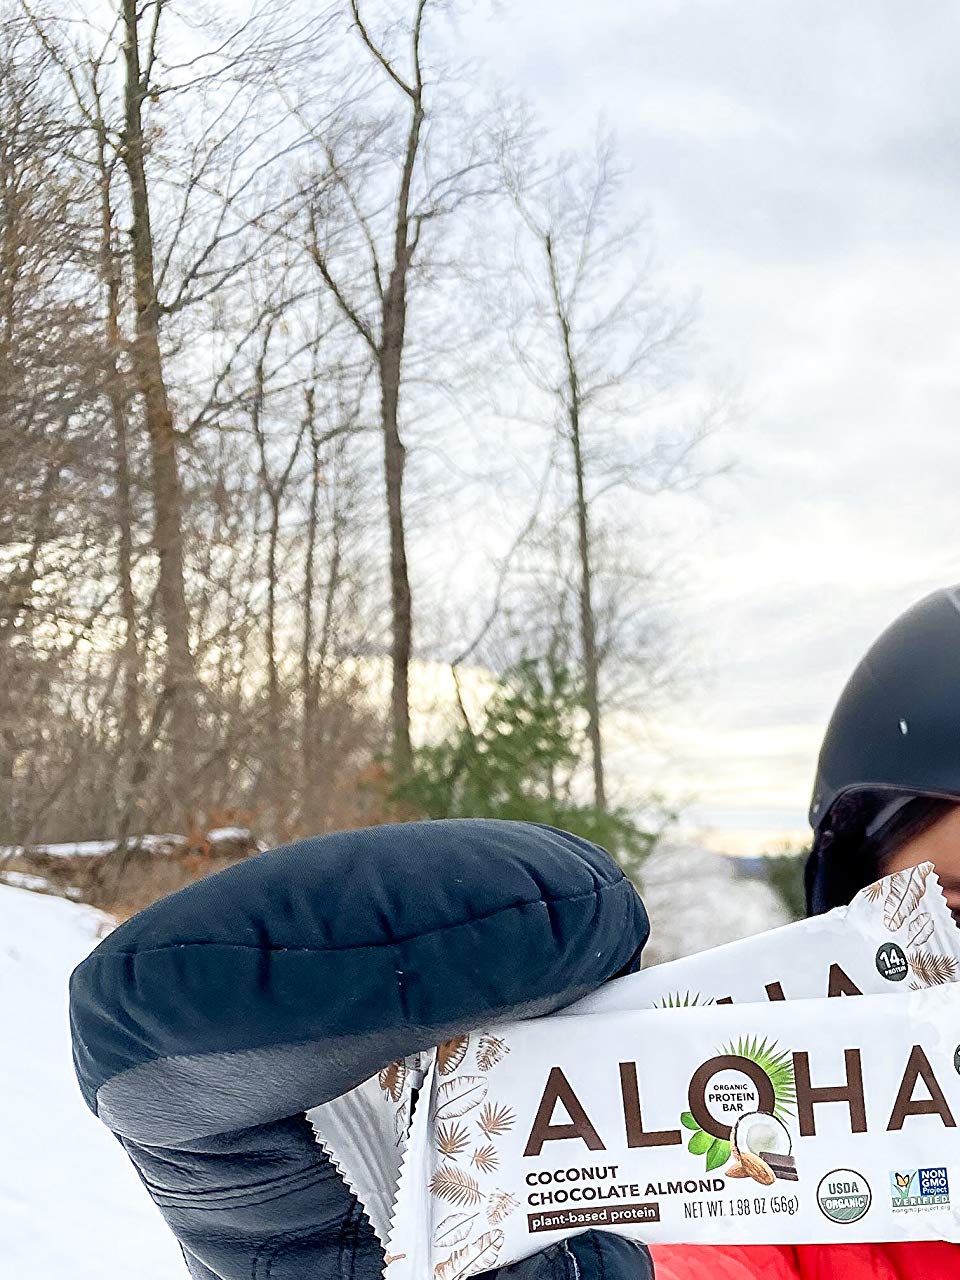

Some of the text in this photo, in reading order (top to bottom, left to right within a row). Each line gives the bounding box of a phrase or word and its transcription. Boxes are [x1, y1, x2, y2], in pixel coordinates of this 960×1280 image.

[713, 1083, 748, 1091] ORGANIC
[523, 1045, 957, 1157] ALOHA
[708, 1092, 755, 1102] PROTEIN
[722, 1103, 744, 1112] BAR
[525, 1165, 619, 1186] COCONUT
[921, 1169, 946, 1179] NON
[828, 1181, 859, 1194] USDA
[921, 1178, 947, 1187] GMO
[527, 1178, 726, 1206] CHOCOLATE ALMOND
[922, 1186, 948, 1195] Project
[684, 1195, 799, 1218] NET WT. 1.98 OZ (56g)
[825, 1197, 864, 1210] ORGANIC
[894, 1195, 948, 1206] VERIFIED
[531, 1207, 656, 1230] plant-based protein
